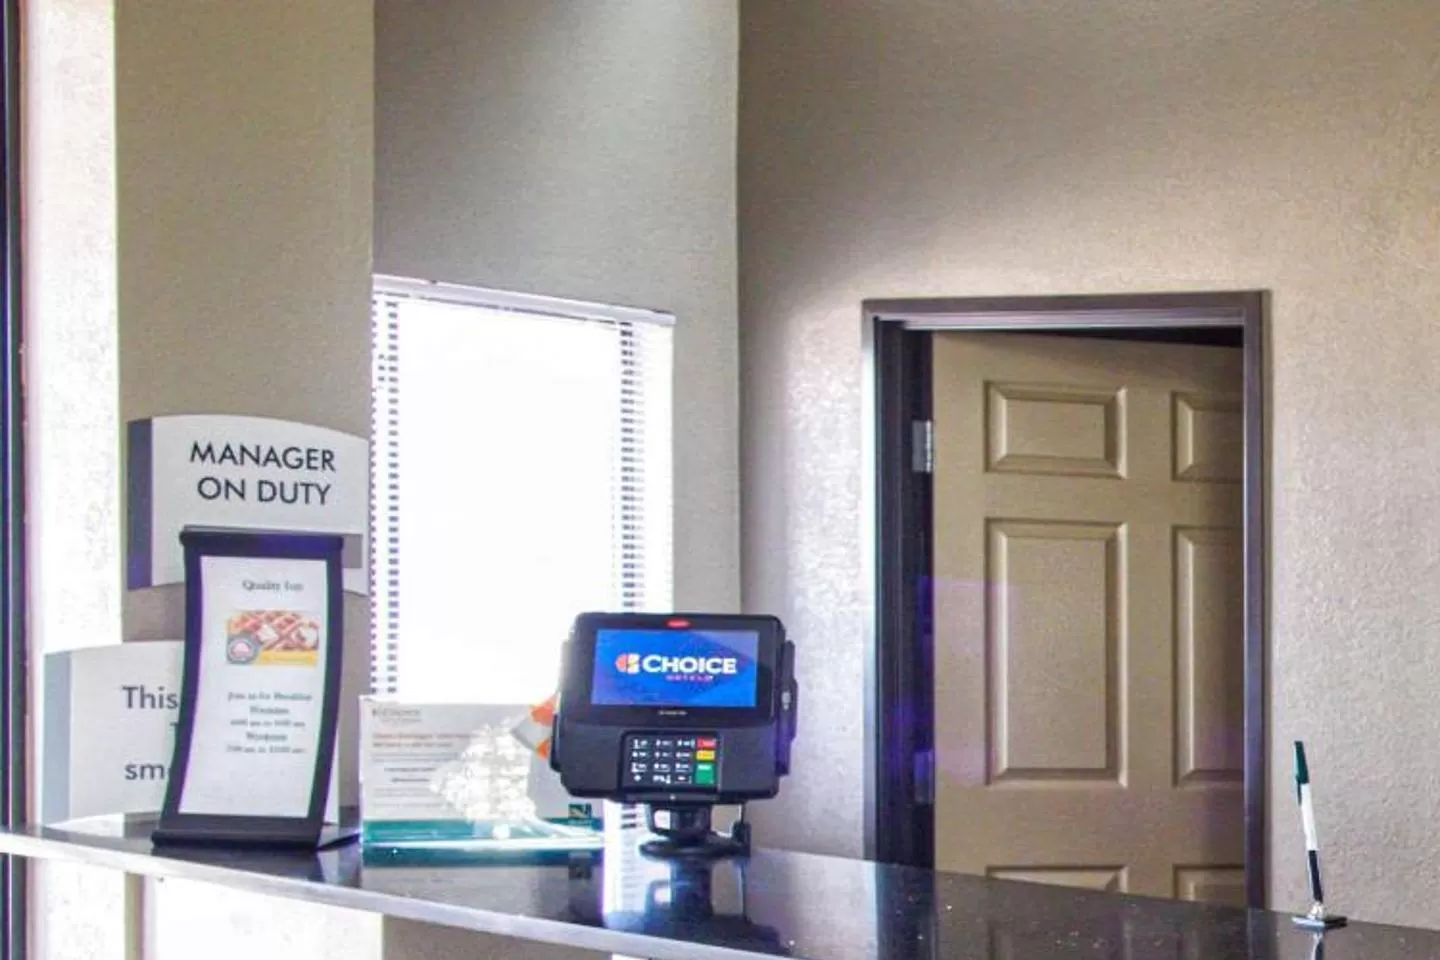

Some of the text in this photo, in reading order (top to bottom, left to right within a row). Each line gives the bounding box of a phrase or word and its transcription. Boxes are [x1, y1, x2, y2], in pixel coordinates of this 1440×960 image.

[190, 440, 336, 473] MANAGER
[197, 476, 332, 506] ON DUTY
[642, 654, 738, 674] CHOICE
[121, 684, 179, 709] This
[124, 763, 167, 780] sm
